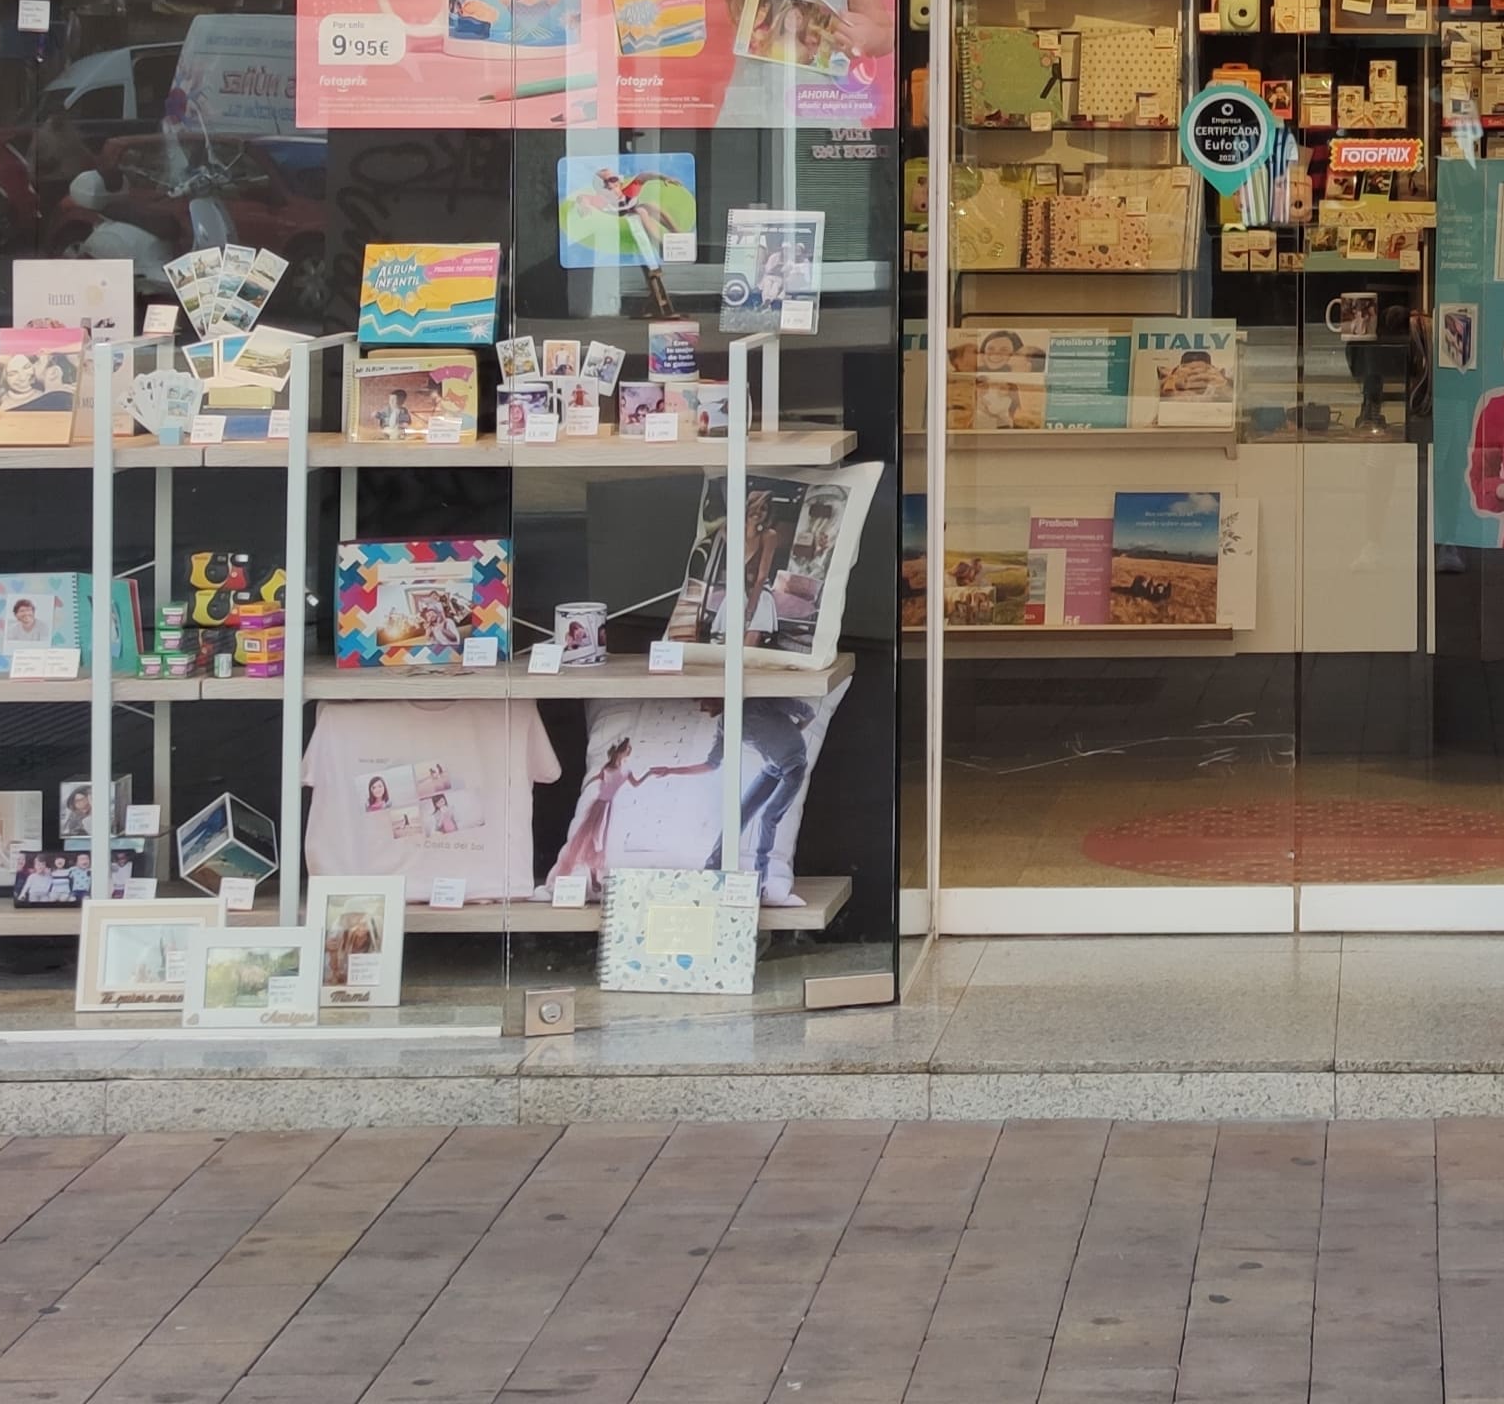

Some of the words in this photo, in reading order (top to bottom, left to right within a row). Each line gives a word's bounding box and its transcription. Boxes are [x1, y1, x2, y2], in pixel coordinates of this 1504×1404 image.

[615, 75, 664, 90] fotoprix
[1211, 116, 1242, 126] Empresa
[1195, 126, 1260, 136] CERTIFICADA
[1340, 146, 1410, 164] FOTOPRIX
[1050, 338, 1094, 347] Fotolibro
[1095, 338, 1117, 347] Plus
[1137, 332, 1232, 351] ITALY
[1038, 518, 1079, 528] Probook
